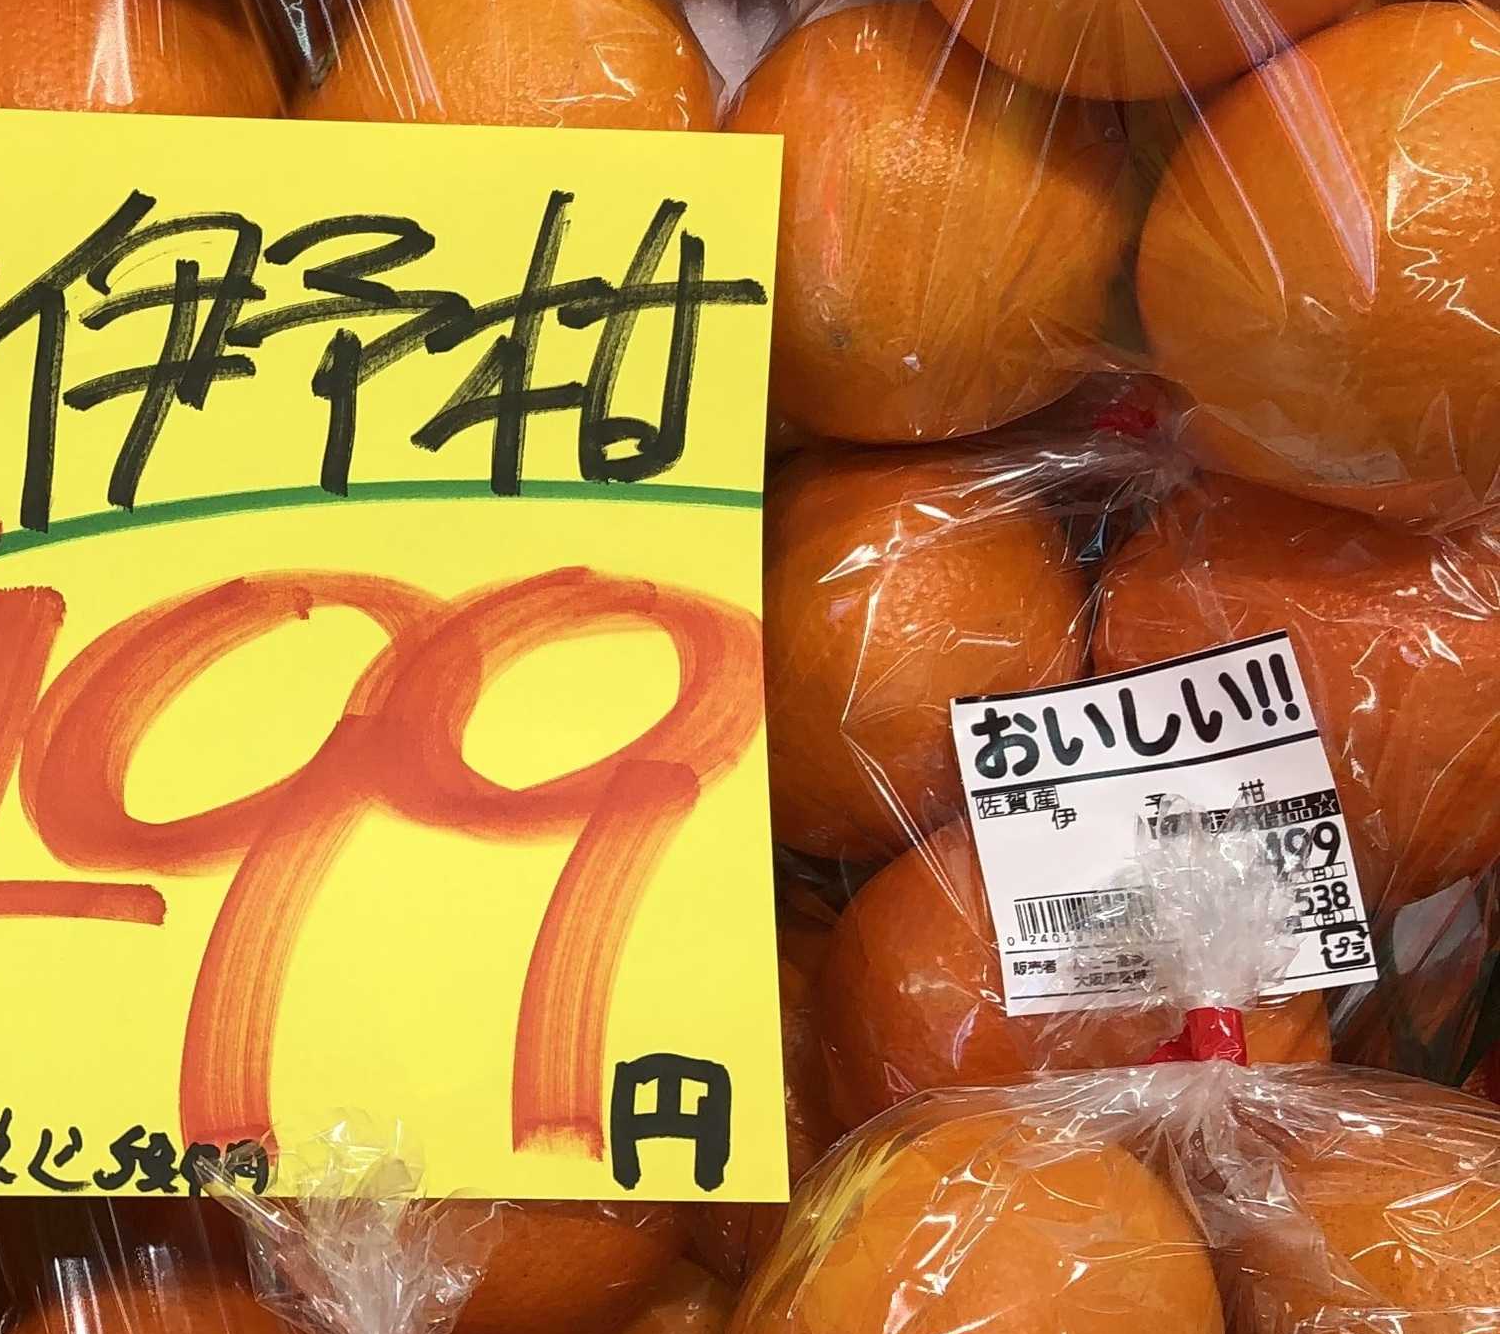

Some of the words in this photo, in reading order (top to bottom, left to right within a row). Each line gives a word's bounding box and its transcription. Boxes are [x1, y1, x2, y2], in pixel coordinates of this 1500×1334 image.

[971, 653, 1300, 779] おいしい!!
[977, 785, 1059, 819] 佐賀産
[1294, 881, 1350, 915] 538
[1334, 937, 1364, 958] プラ
[1013, 960, 1057, 976] 販売者
